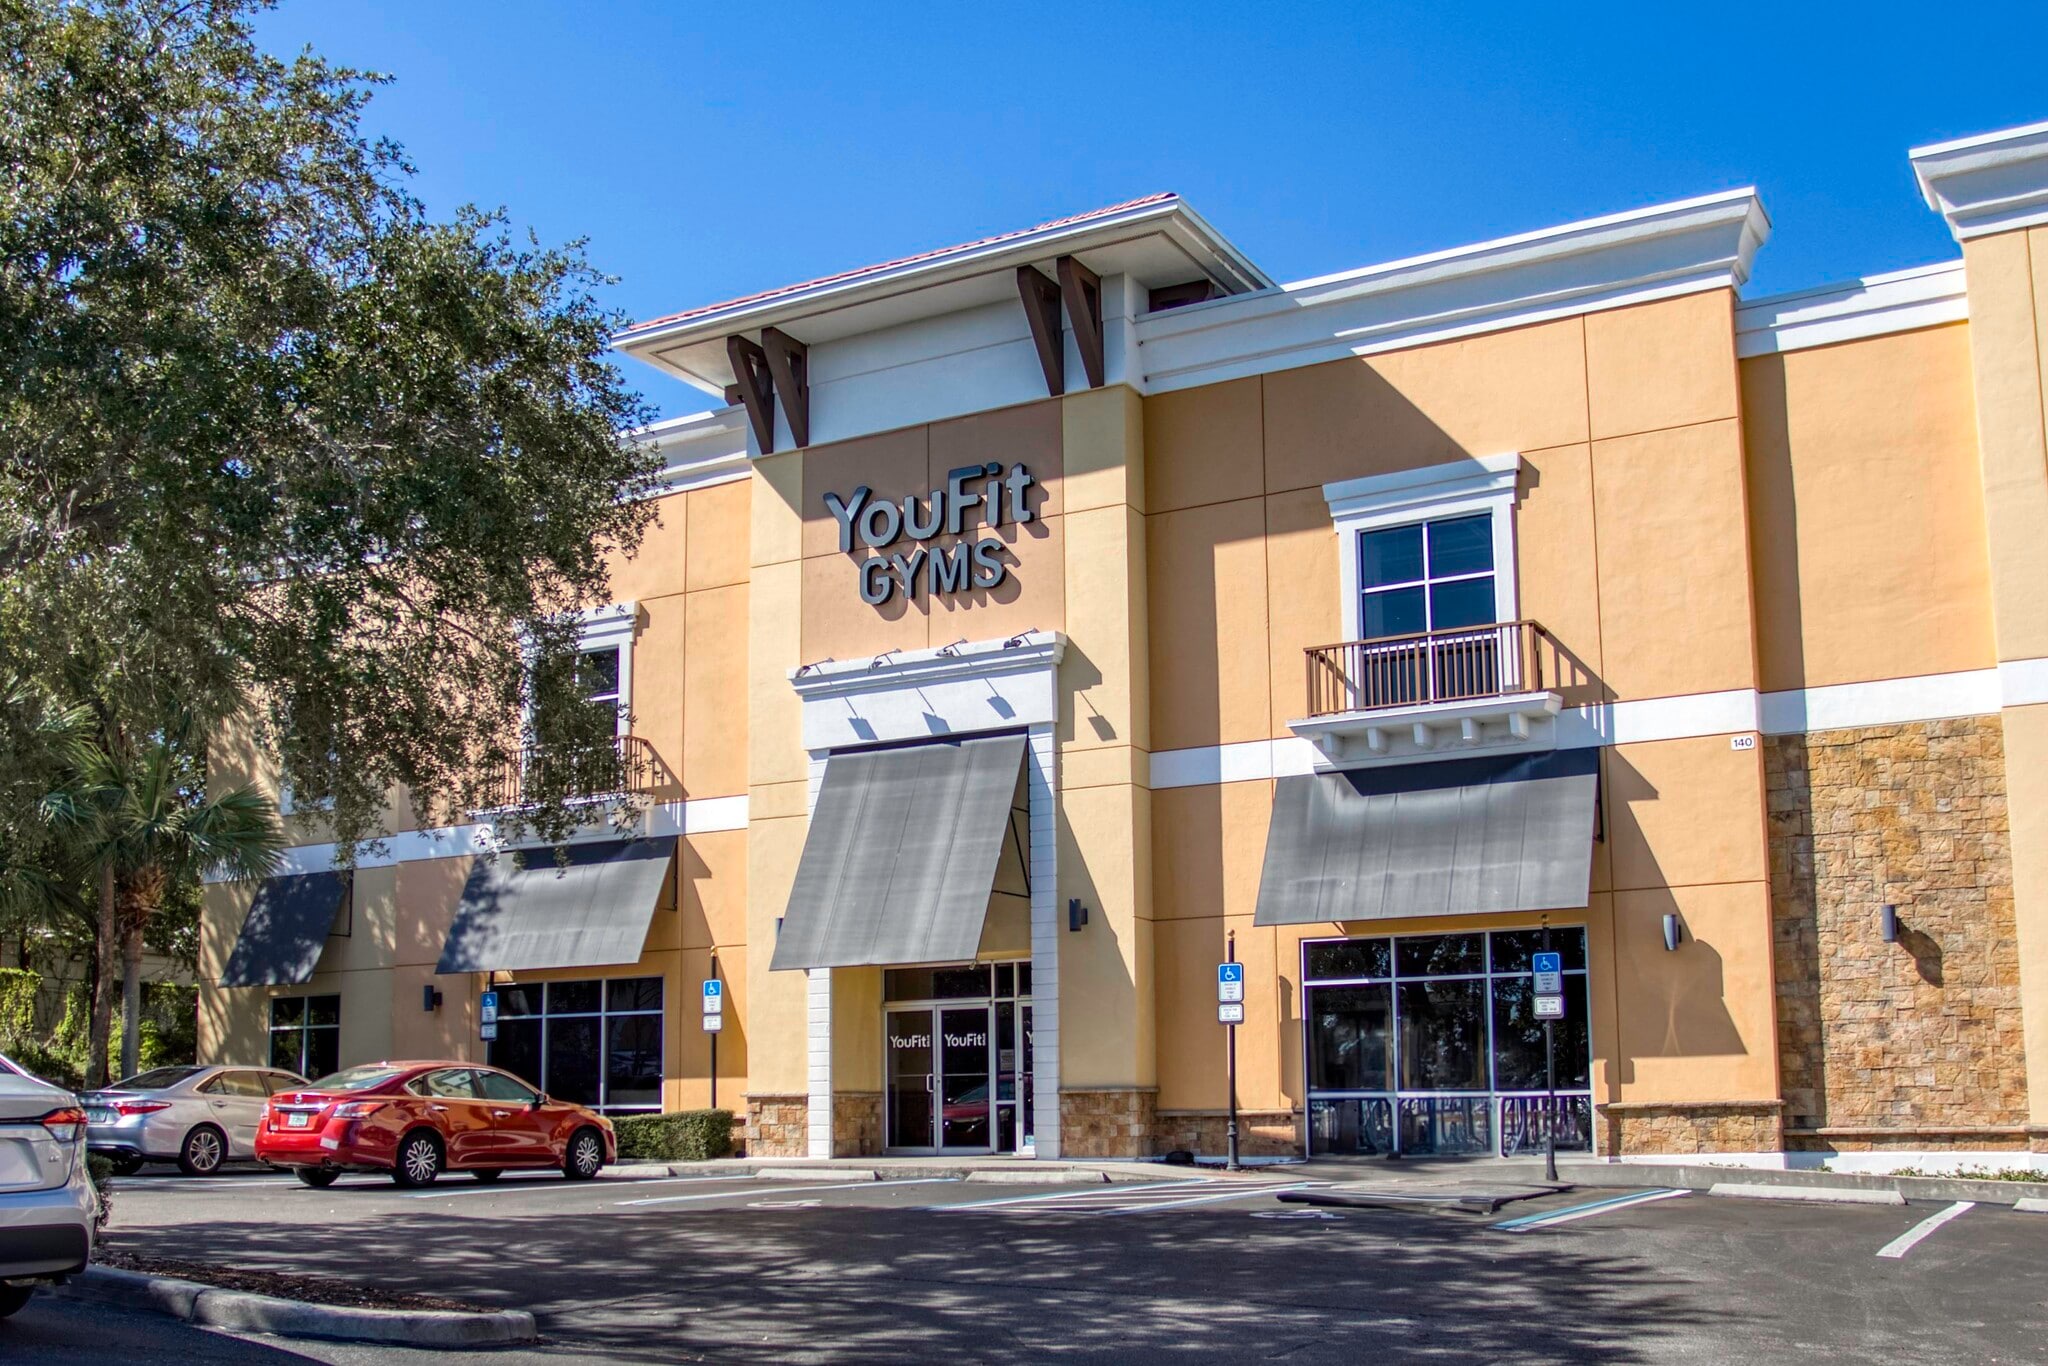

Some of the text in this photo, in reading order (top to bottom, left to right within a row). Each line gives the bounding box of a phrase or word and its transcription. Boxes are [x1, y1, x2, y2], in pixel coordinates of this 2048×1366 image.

[823, 462, 1035, 554] YouFit
[859, 537, 1007, 605] GYMS
[1733, 737, 1753, 748] 140
[890, 1034, 926, 1048] YouFit
[944, 1033, 981, 1047] YouFit
